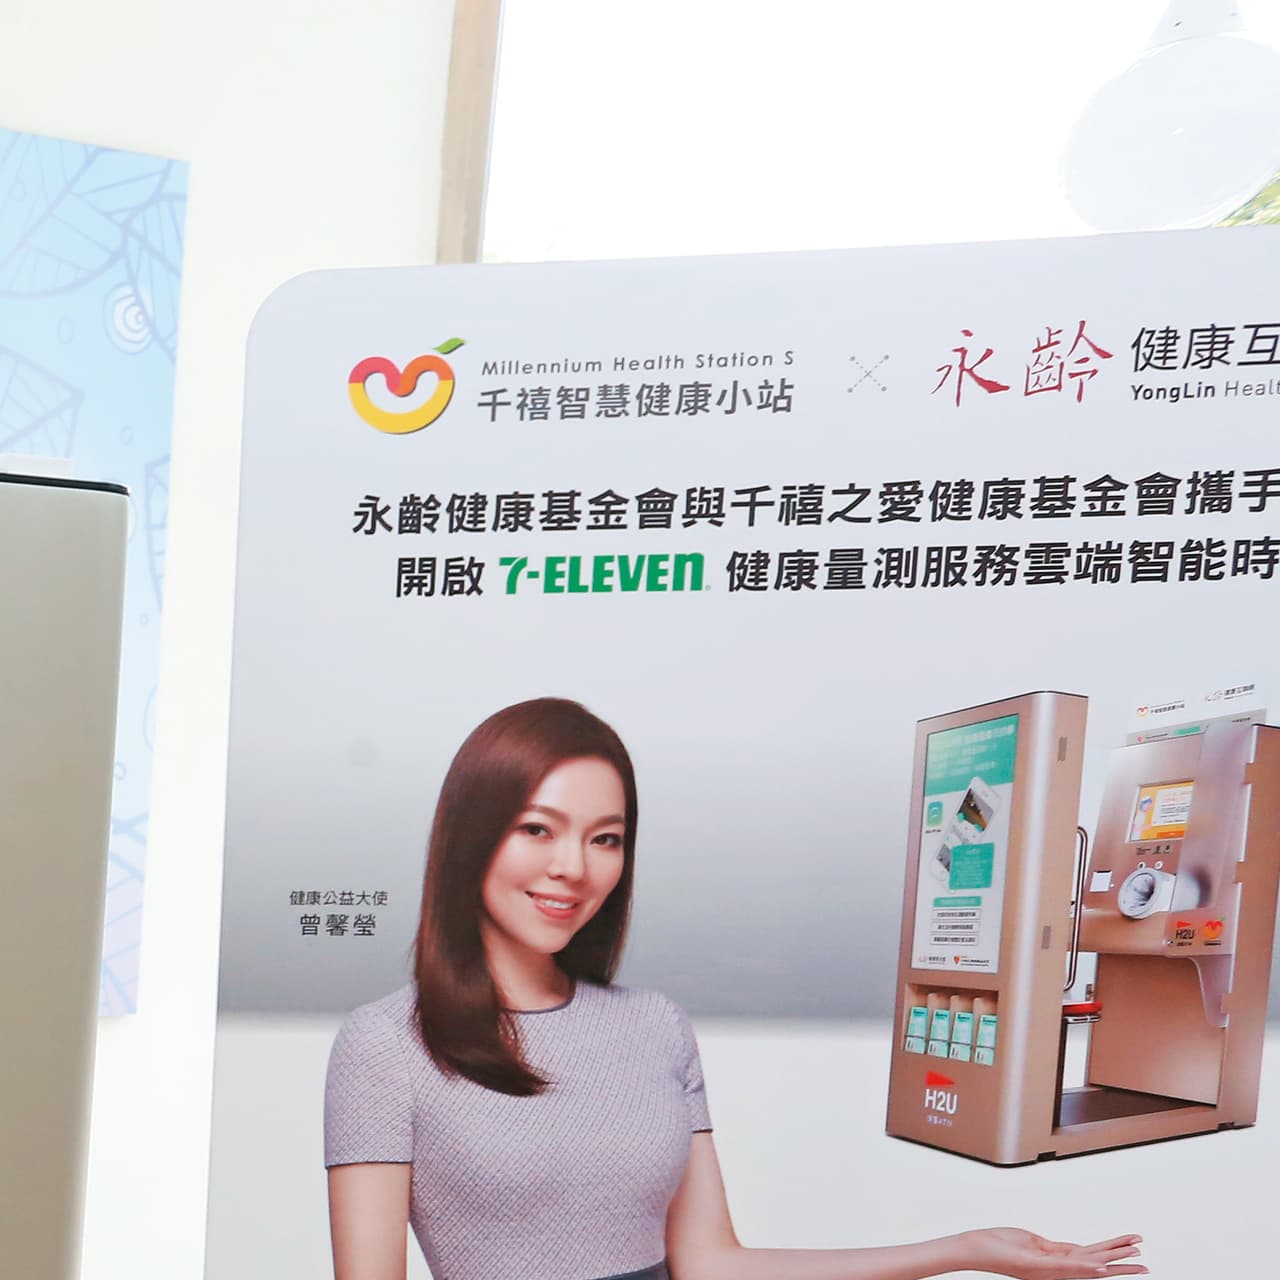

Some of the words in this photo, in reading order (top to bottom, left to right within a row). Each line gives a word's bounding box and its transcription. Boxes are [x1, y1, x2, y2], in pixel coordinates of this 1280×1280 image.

[482, 358, 602, 376] Millennium
[614, 354, 684, 372] Health
[695, 351, 773, 369] Station
[784, 350, 794, 365] S
[931, 321, 1114, 408] 永齡
[1131, 323, 1280, 372] 健康互
[477, 378, 794, 422] 千禧智慧健康小站
[1131, 381, 1216, 403] YongLin
[353, 468, 1280, 535] 永齡健康基金會與千禧之愛健康基金會攜手
[396, 556, 485, 598] 開啟
[726, 536, 1280, 592] 健康量測服務雲端智能時
[289, 890, 388, 906] 健康公益大使
[300, 913, 377, 936] 曾馨瑩
[924, 1088, 958, 1115] H2U
